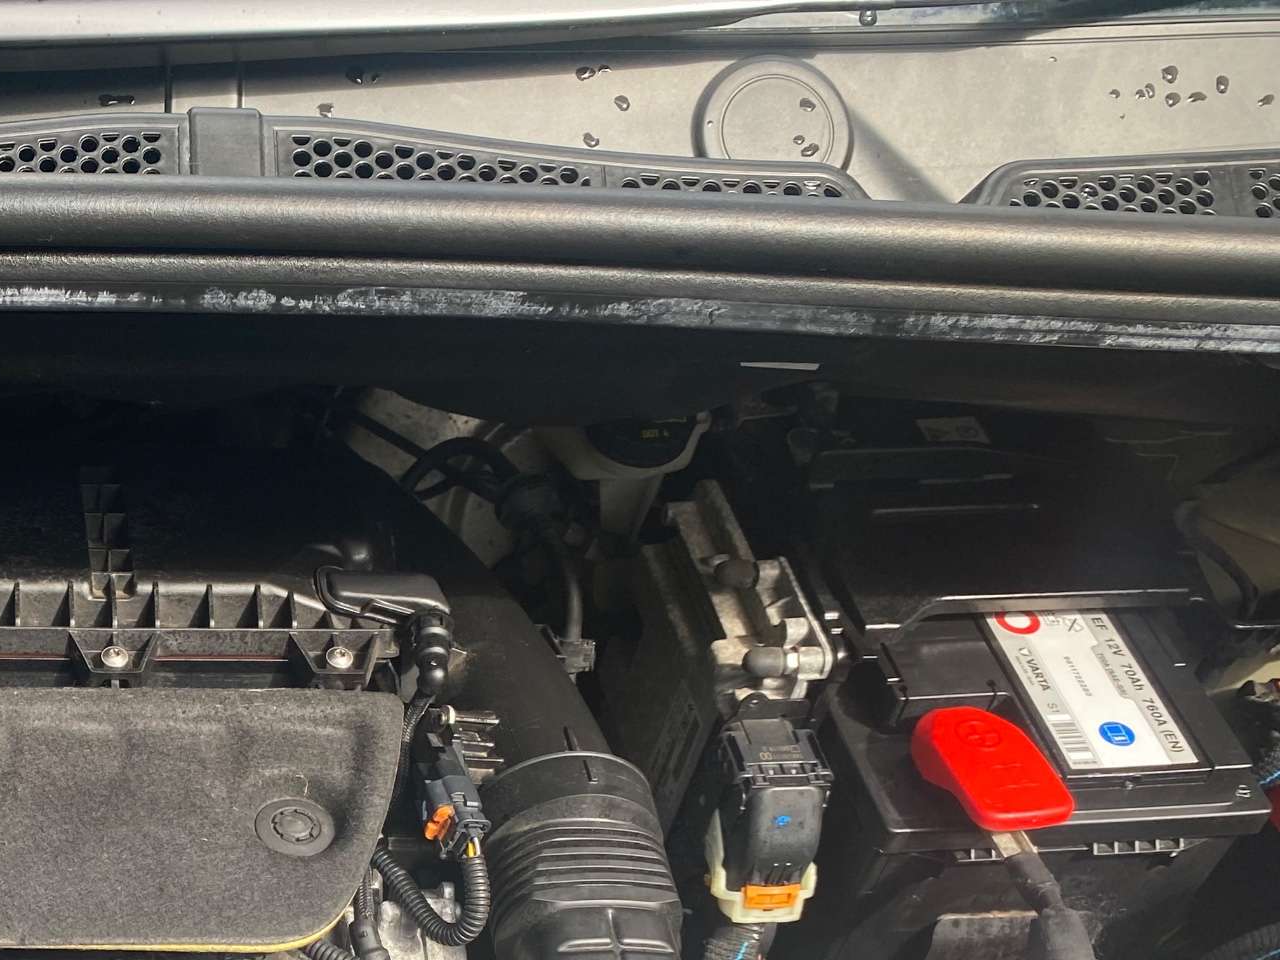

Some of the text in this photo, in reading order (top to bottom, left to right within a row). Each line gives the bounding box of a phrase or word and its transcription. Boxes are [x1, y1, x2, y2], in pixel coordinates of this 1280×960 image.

[1027, 659, 1051, 692] VARTA
[1090, 616, 1108, 632] EF
[1105, 637, 1124, 658] 12V
[1121, 662, 1144, 692] 70Ah
[1141, 697, 1166, 727] 760A
[1160, 725, 1185, 753] (EN)
